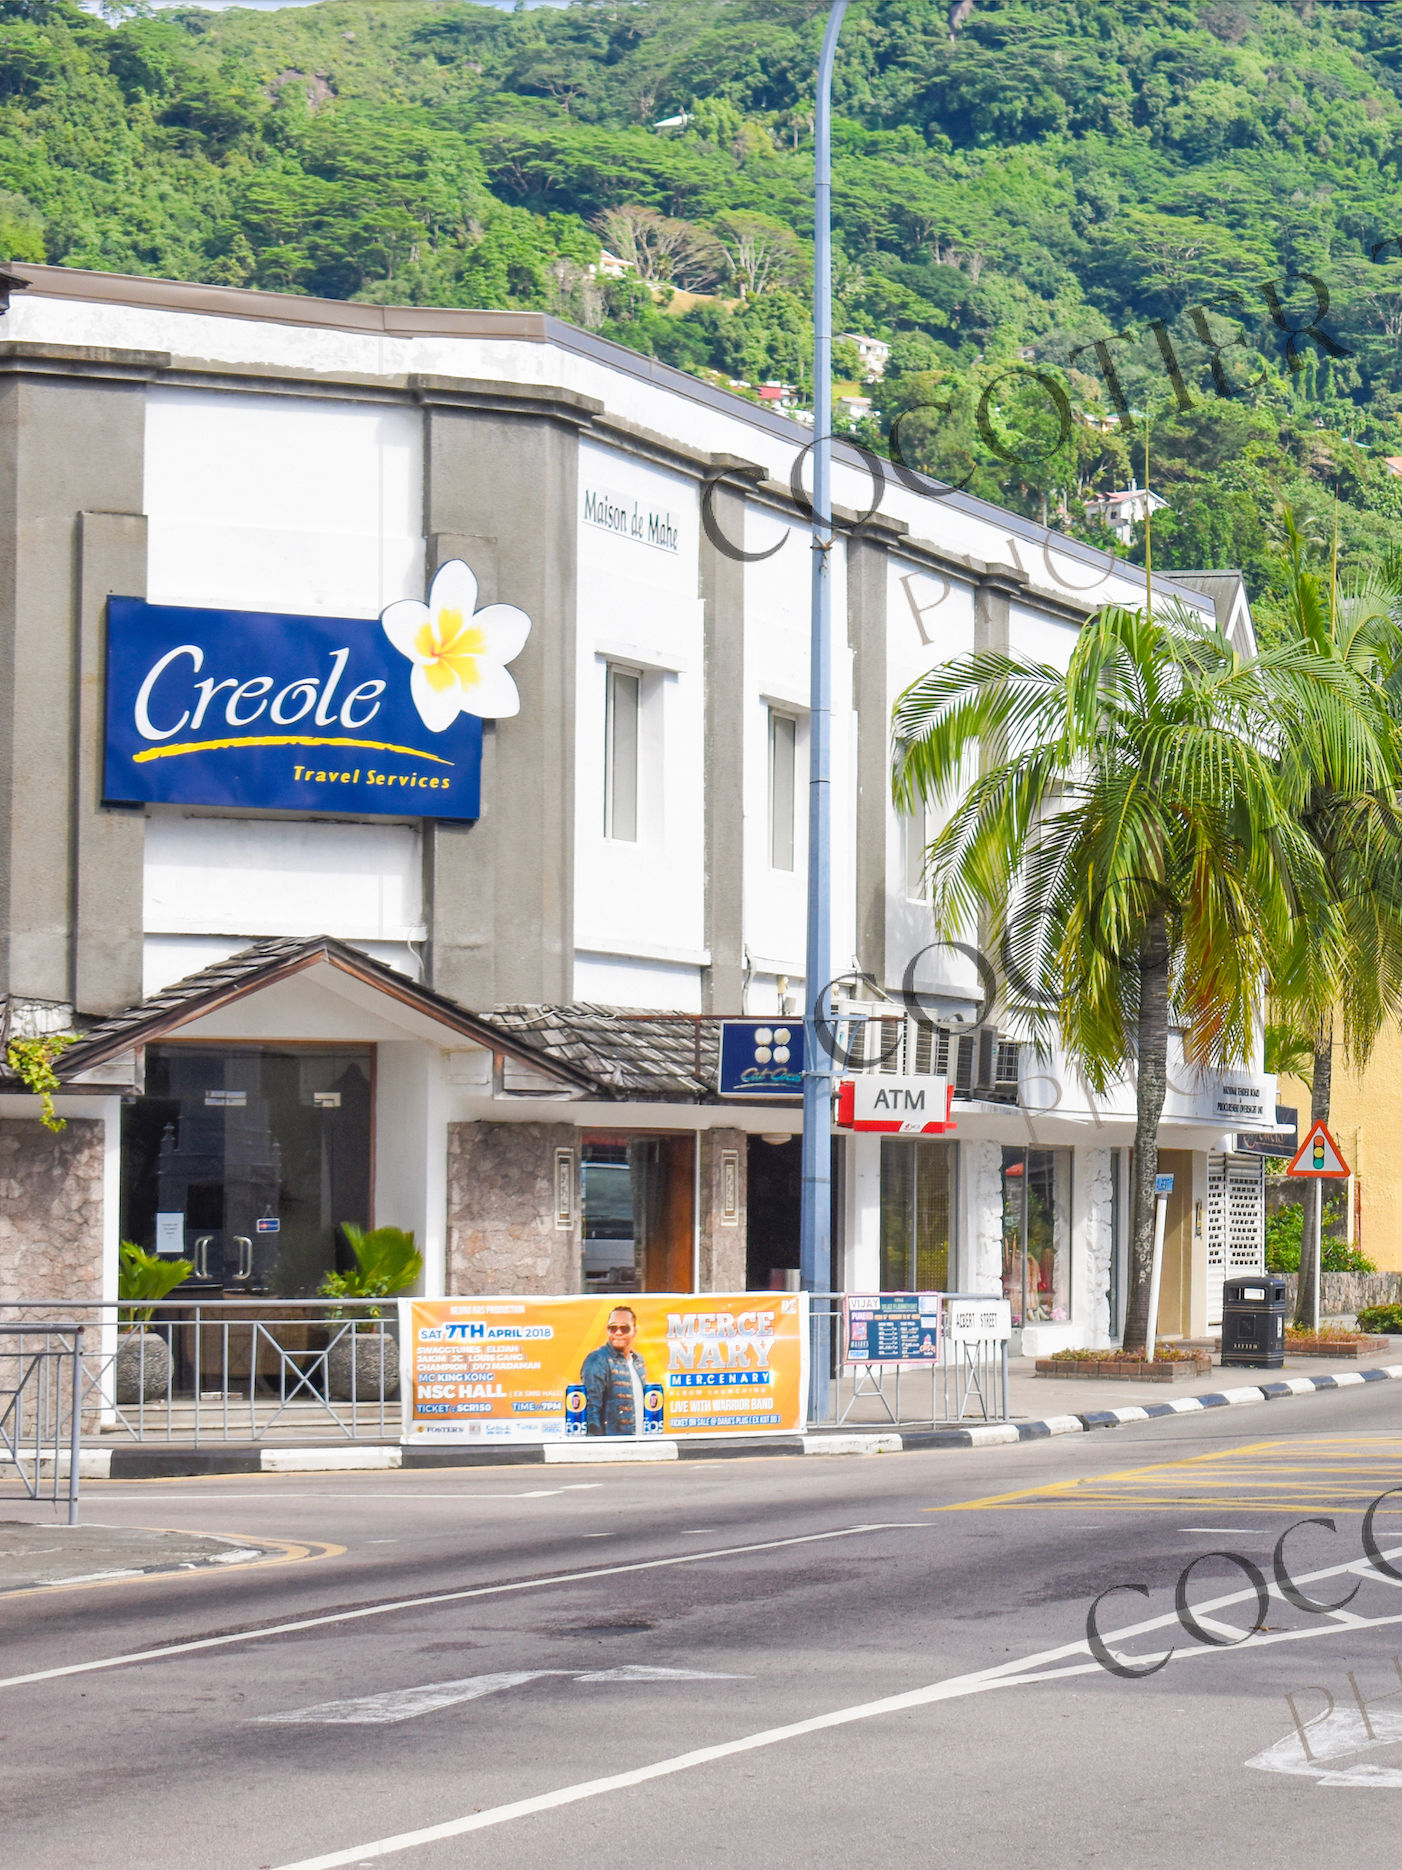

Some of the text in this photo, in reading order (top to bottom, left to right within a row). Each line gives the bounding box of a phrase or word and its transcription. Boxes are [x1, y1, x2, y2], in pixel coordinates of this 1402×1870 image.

[584, 489, 678, 550] Maison de Mahe
[134, 644, 387, 740] Creole
[293, 766, 451, 789] Travel Services
[873, 1089, 925, 1109] ATM
[850, 1298, 878, 1308] VIJAY
[421, 1324, 551, 1339] SAT 7TH APRIL 2018
[667, 1311, 774, 1338] MERCE
[668, 1338, 774, 1369] NARY
[437, 1373, 464, 1381] KING
[465, 1372, 494, 1381] KONG
[417, 1384, 456, 1399] NSC
[458, 1384, 507, 1398] HALL
[417, 1404, 450, 1413] TICKET
[512, 1402, 535, 1411] TIME
[670, 1398, 774, 1413] LIVE WITH WARRIOR BAND
